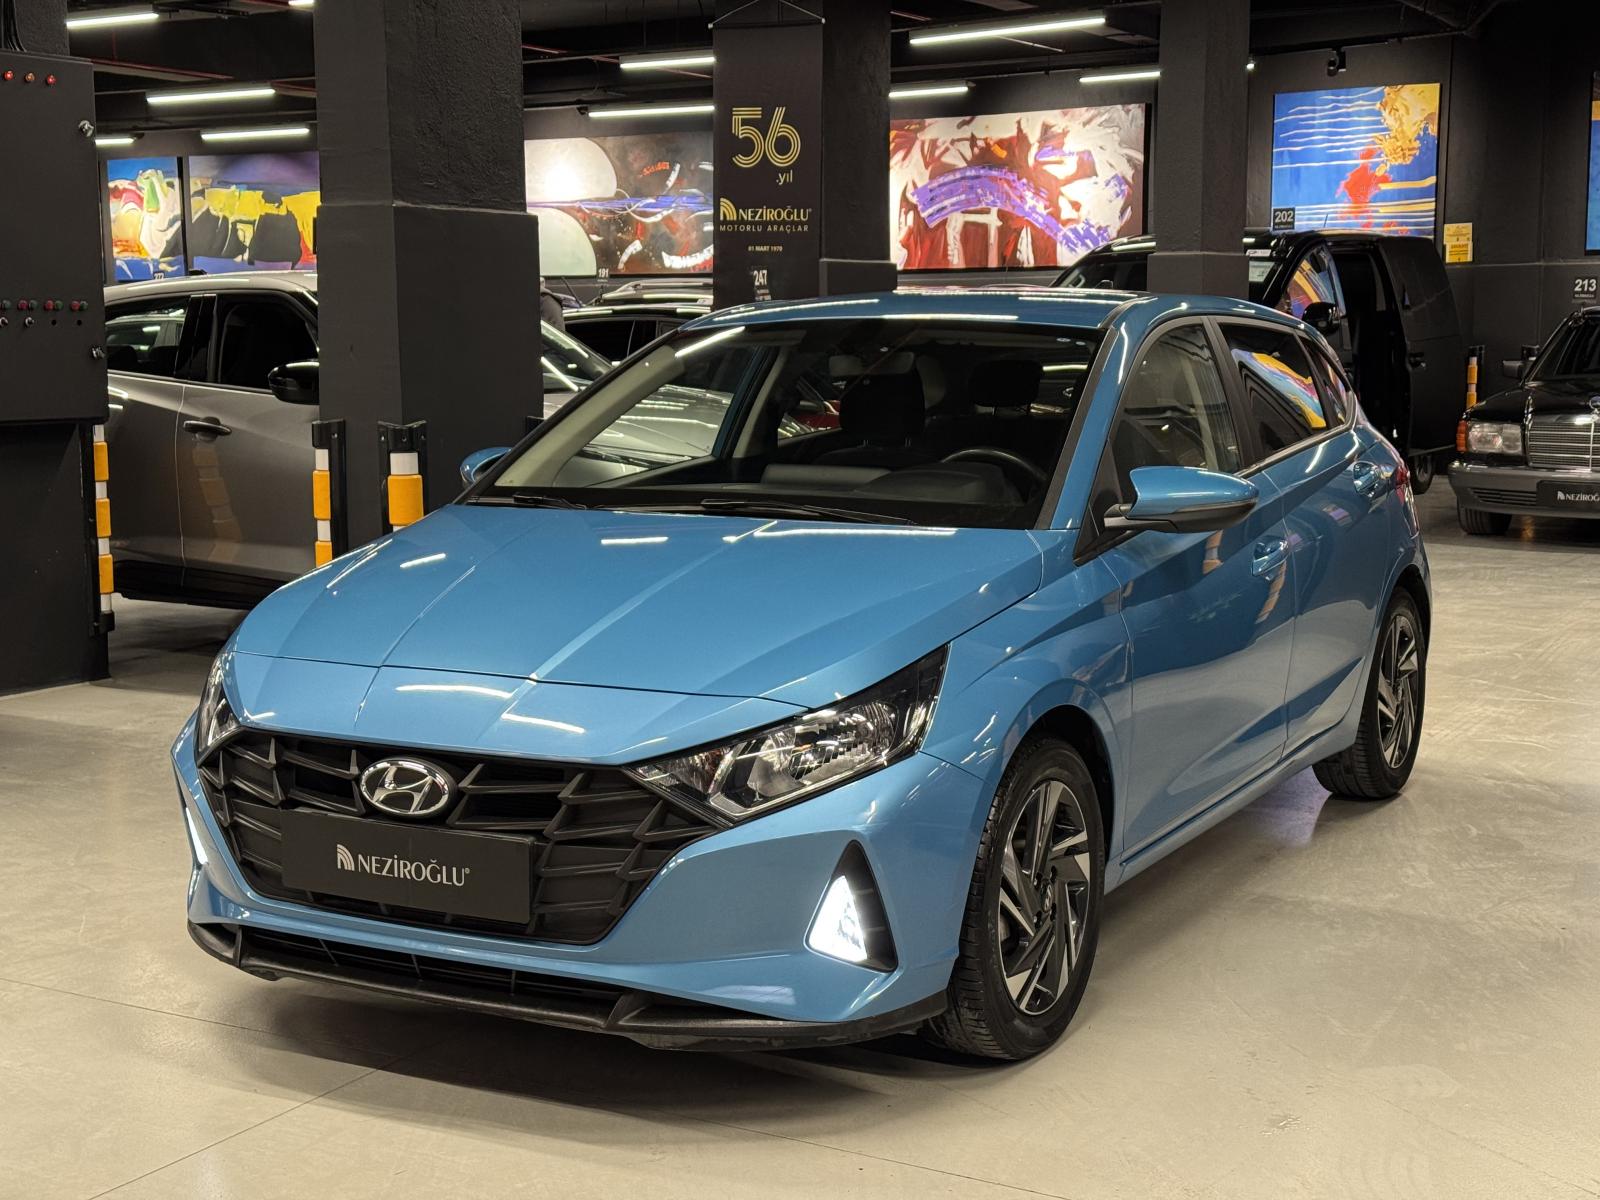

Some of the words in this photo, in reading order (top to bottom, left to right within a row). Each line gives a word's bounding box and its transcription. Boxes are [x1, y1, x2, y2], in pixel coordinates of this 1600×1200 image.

[732, 107, 801, 168] 56
[1274, 210, 1294, 223] 202
[719, 224, 762, 232] MOTORLU
[767, 224, 809, 234] ARAÇLAR
[753, 269, 768, 286] 247
[1574, 278, 1597, 292] 213
